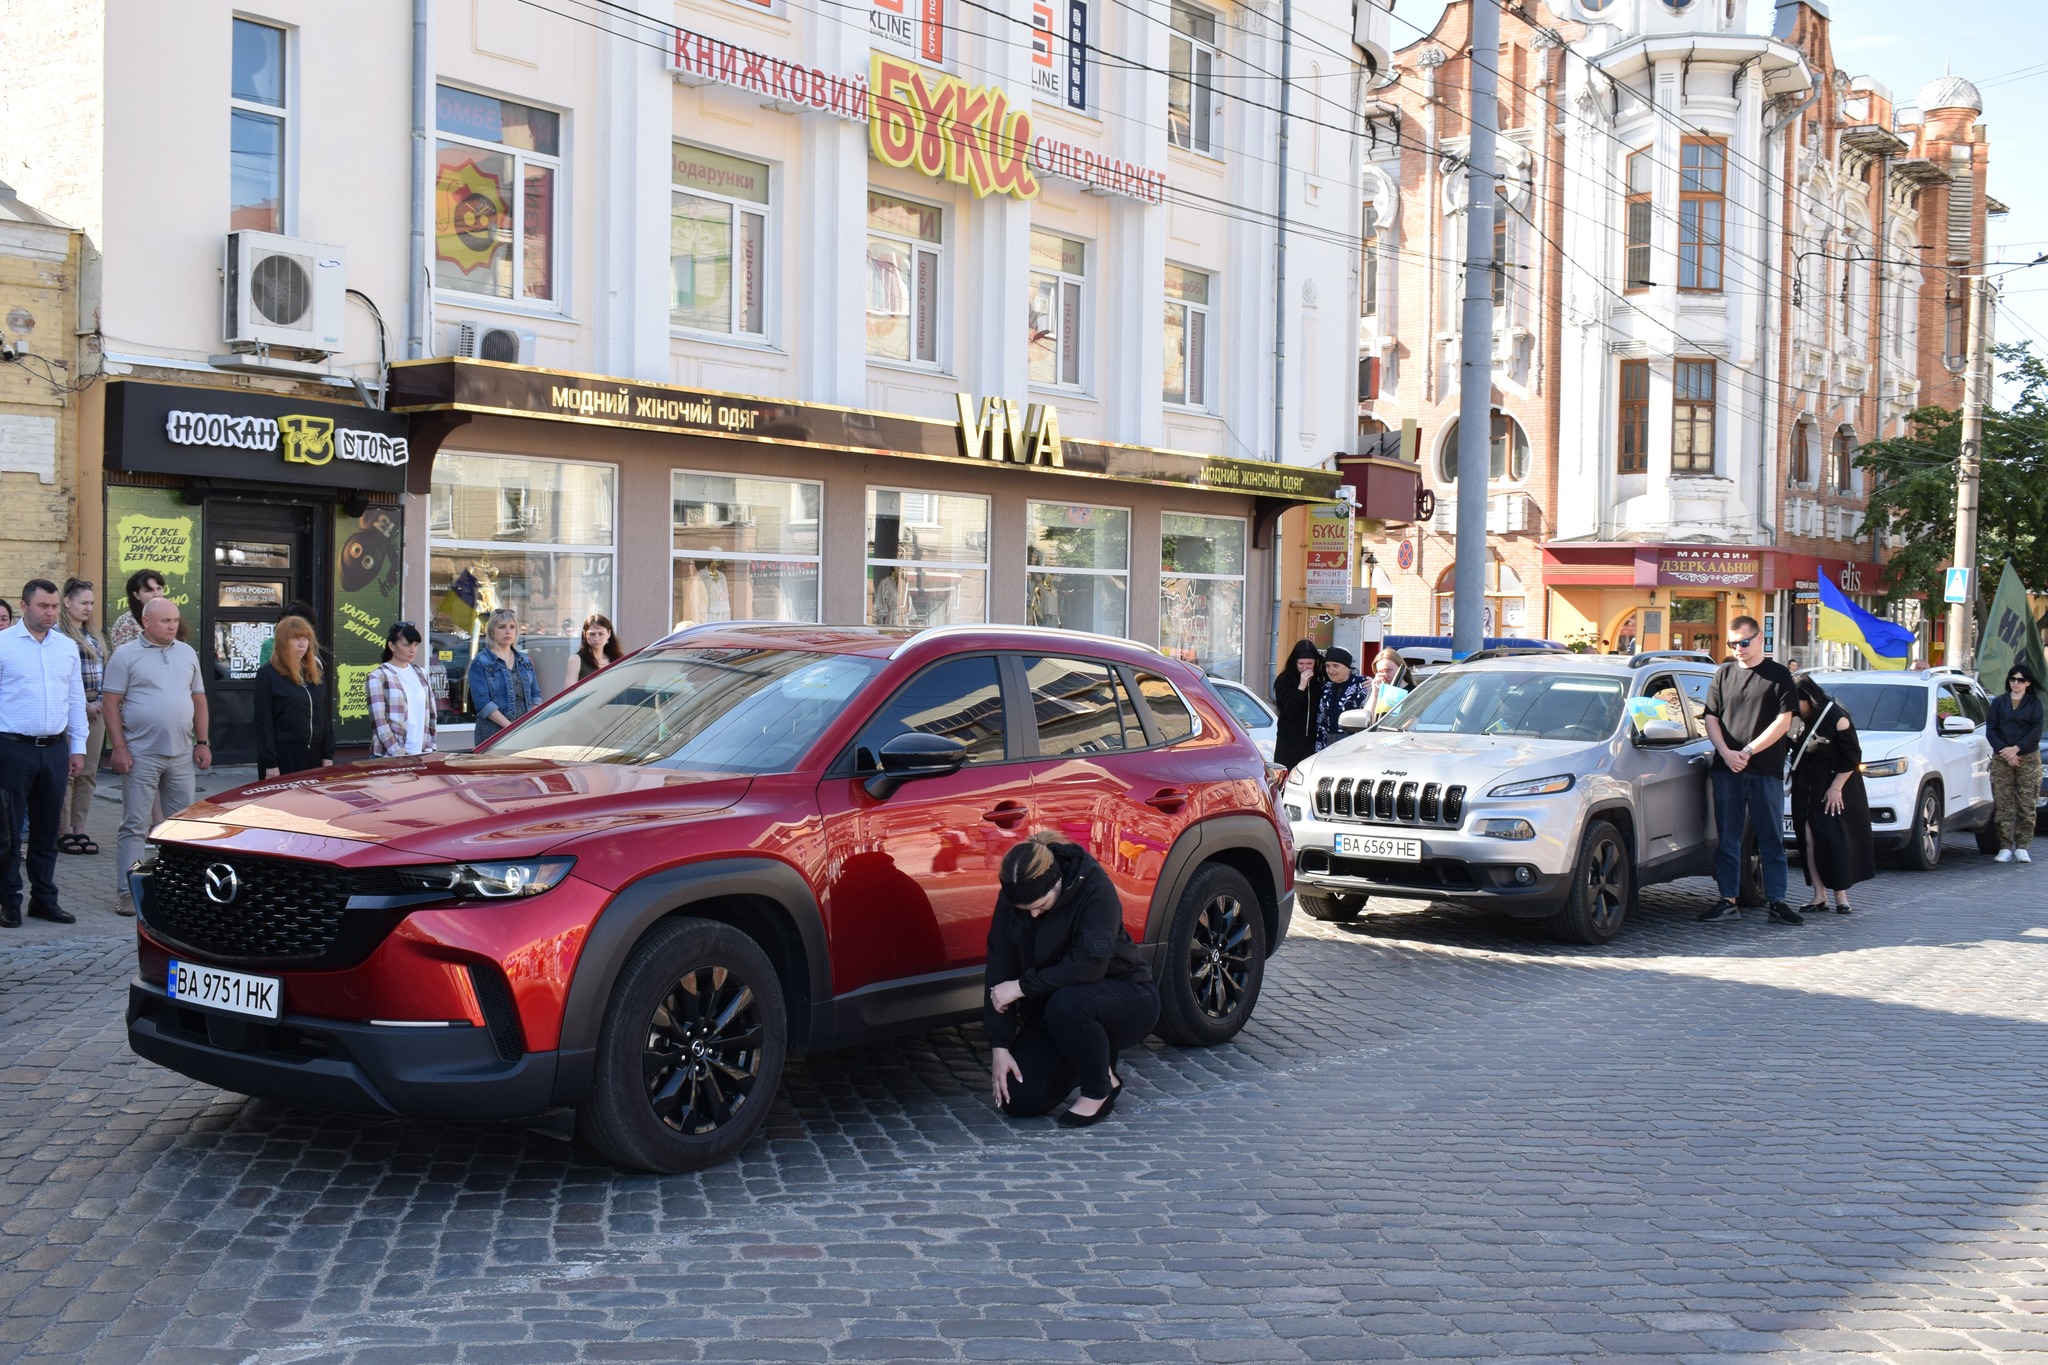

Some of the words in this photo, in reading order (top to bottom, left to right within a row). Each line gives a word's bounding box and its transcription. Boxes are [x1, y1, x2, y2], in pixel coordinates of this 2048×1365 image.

[870, 9, 912, 40] KLINE
[675, 27, 869, 122] КНИЖКОВИЙ
[1031, 67, 1059, 92] LINE
[873, 58, 1038, 198] БУКИ
[1033, 135, 1166, 205] СУПЕРМАРКЕТ
[919, 261, 927, 284] 000
[552, 386, 629, 416] МОДНИЙ
[636, 396, 712, 425] ЖІНОЧИЙ
[718, 406, 760, 431] ОДЯГ
[173, 414, 276, 448] HOOKAH
[286, 417, 332, 460] 13
[342, 432, 407, 464] STORE
[1200, 464, 1239, 486] МОДНИЙ
[1241, 469, 1280, 489] ЖІНОЧИЙ
[1282, 475, 1304, 493] ОДЯГ
[123, 535, 153, 544] КОЛИ
[154, 536, 187, 545] ХОЧЕШ
[131, 526, 151, 535] ТУТ
[151, 527, 160, 536] Є
[160, 528, 180, 536] ВСЕ
[1312, 524, 1346, 540] БУКИ
[124, 553, 144, 562] БЕЗ
[161, 546, 182, 554] АЛЕ
[1315, 553, 1321, 562] 2
[1677, 550, 1749, 559] МАГАЗИН
[1660, 558, 1759, 574] ДЗЕРКАЛЬНИЙ
[1840, 561, 1861, 592] elis
[225, 586, 247, 594] ГРАФІК
[339, 602, 381, 629] ХАПАЙ
[350, 684, 364, 692] ВСЕ
[1381, 769, 1408, 777] Jeep
[1343, 837, 1361, 853] BA
[1364, 839, 1394, 856] 6569
[1397, 842, 1417, 857] HE
[178, 967, 198, 998] BA
[203, 972, 241, 1006] 9751
[246, 980, 274, 1012] HK
